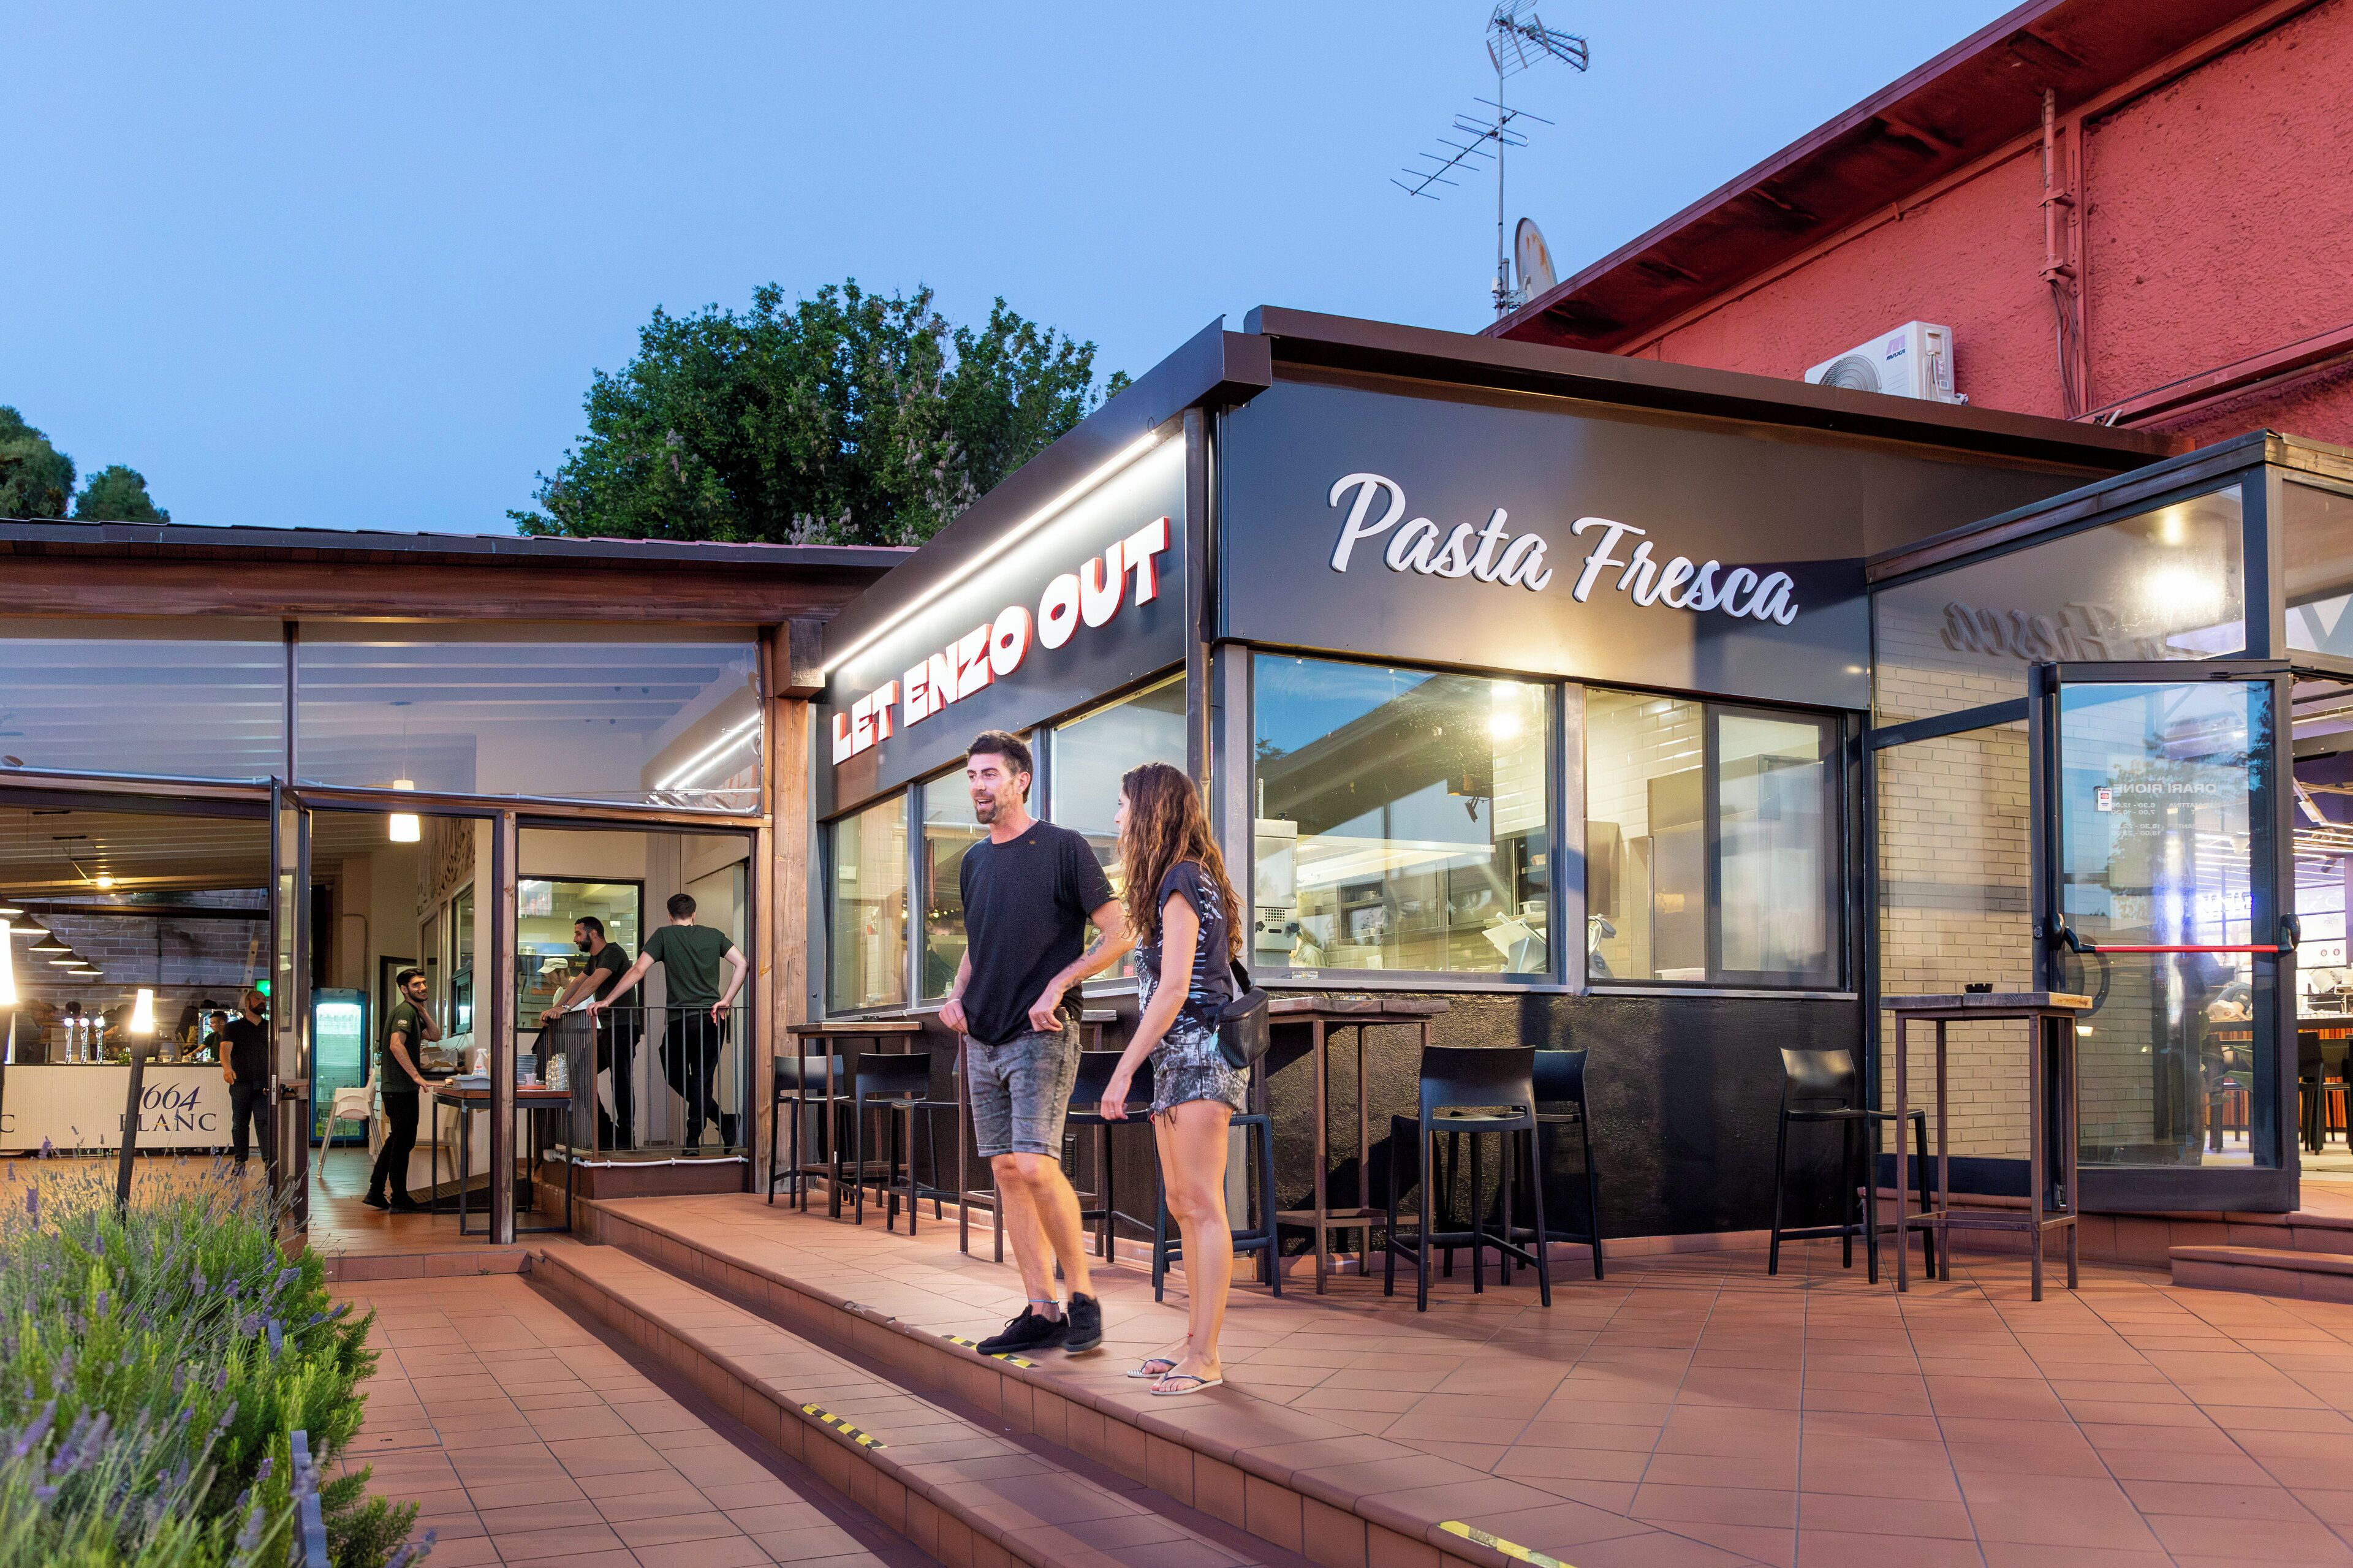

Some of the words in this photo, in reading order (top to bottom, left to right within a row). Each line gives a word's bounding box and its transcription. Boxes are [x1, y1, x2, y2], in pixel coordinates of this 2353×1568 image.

[832, 680, 899, 766] LET
[904, 605, 1032, 727] ENZO
[1037, 516, 1169, 650] OUT
[1328, 472, 1553, 592] Pasta
[1570, 517, 1799, 626] Fresca
